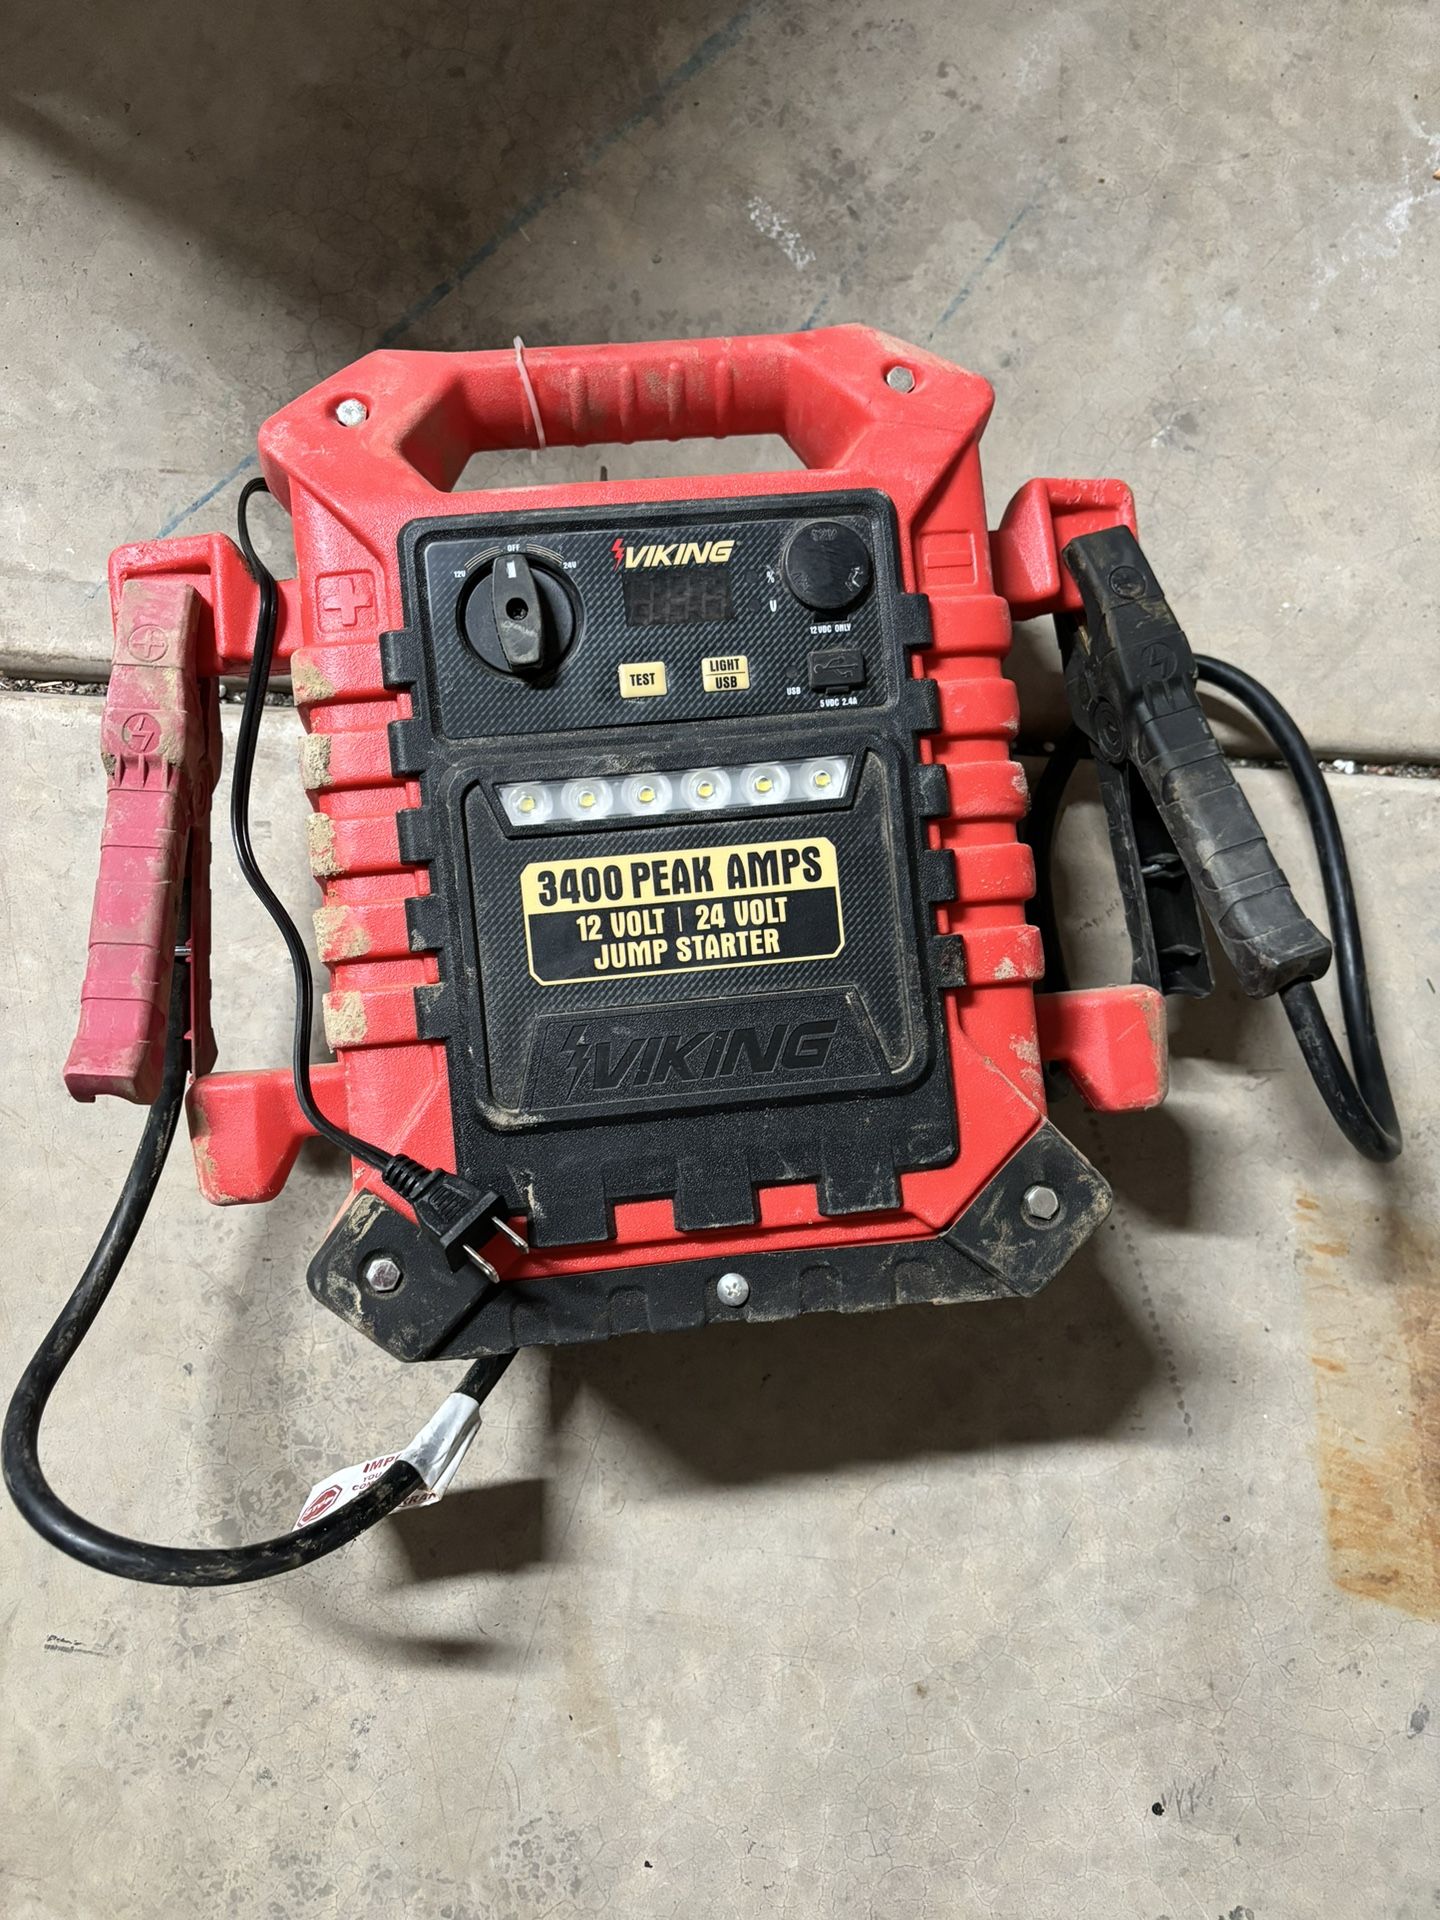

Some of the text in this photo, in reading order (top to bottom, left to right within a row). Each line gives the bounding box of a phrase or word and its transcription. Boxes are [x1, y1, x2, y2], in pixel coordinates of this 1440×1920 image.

[507, 544, 520, 552] OFF
[624, 540, 735, 569] VIKING
[766, 569, 775, 583] %
[834, 623, 851, 632] ONLY
[709, 658, 740, 672] LIGHT
[629, 672, 656, 687] TEST
[715, 676, 738, 689] USB
[786, 686, 801, 695] USB
[537, 846, 823, 907] 3400 PEAK AMPS
[576, 897, 788, 942] 12 VOLT 24 VOLT
[594, 928, 781, 970] JUMP STARTER
[593, 1019, 839, 1092] VIKING
